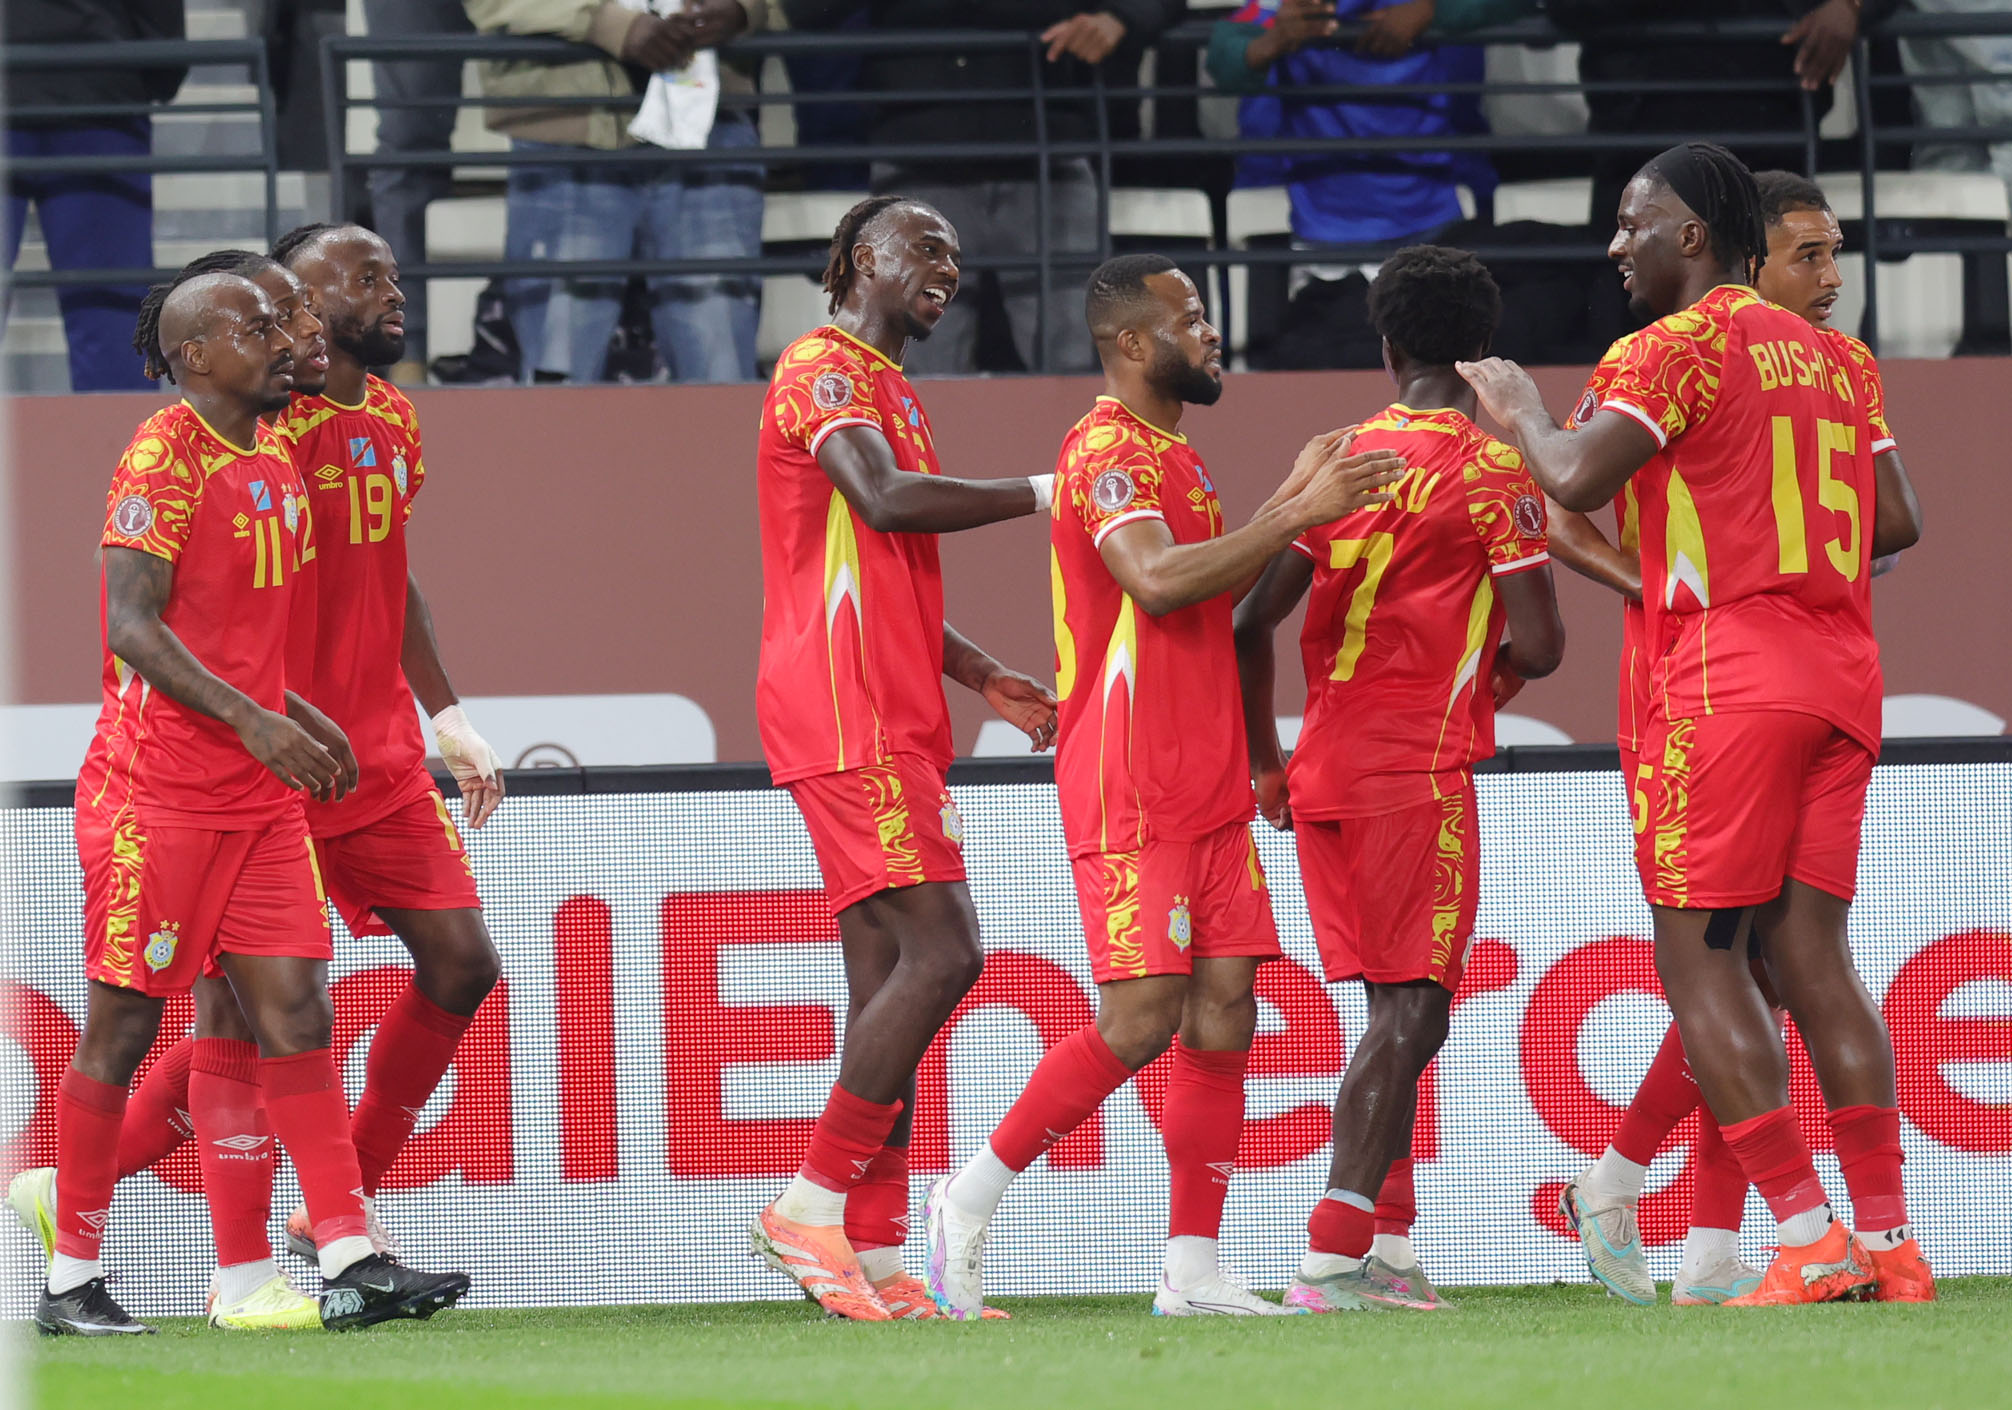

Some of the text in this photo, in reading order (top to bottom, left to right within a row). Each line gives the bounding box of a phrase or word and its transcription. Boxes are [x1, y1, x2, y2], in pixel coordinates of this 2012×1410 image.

[318, 480, 344, 491] umbro
[348, 473, 393, 545] 19
[1771, 415, 1861, 583] 15
[253, 516, 284, 589] 11
[1329, 531, 1394, 682] 7
[218, 1151, 269, 1161] umbro
